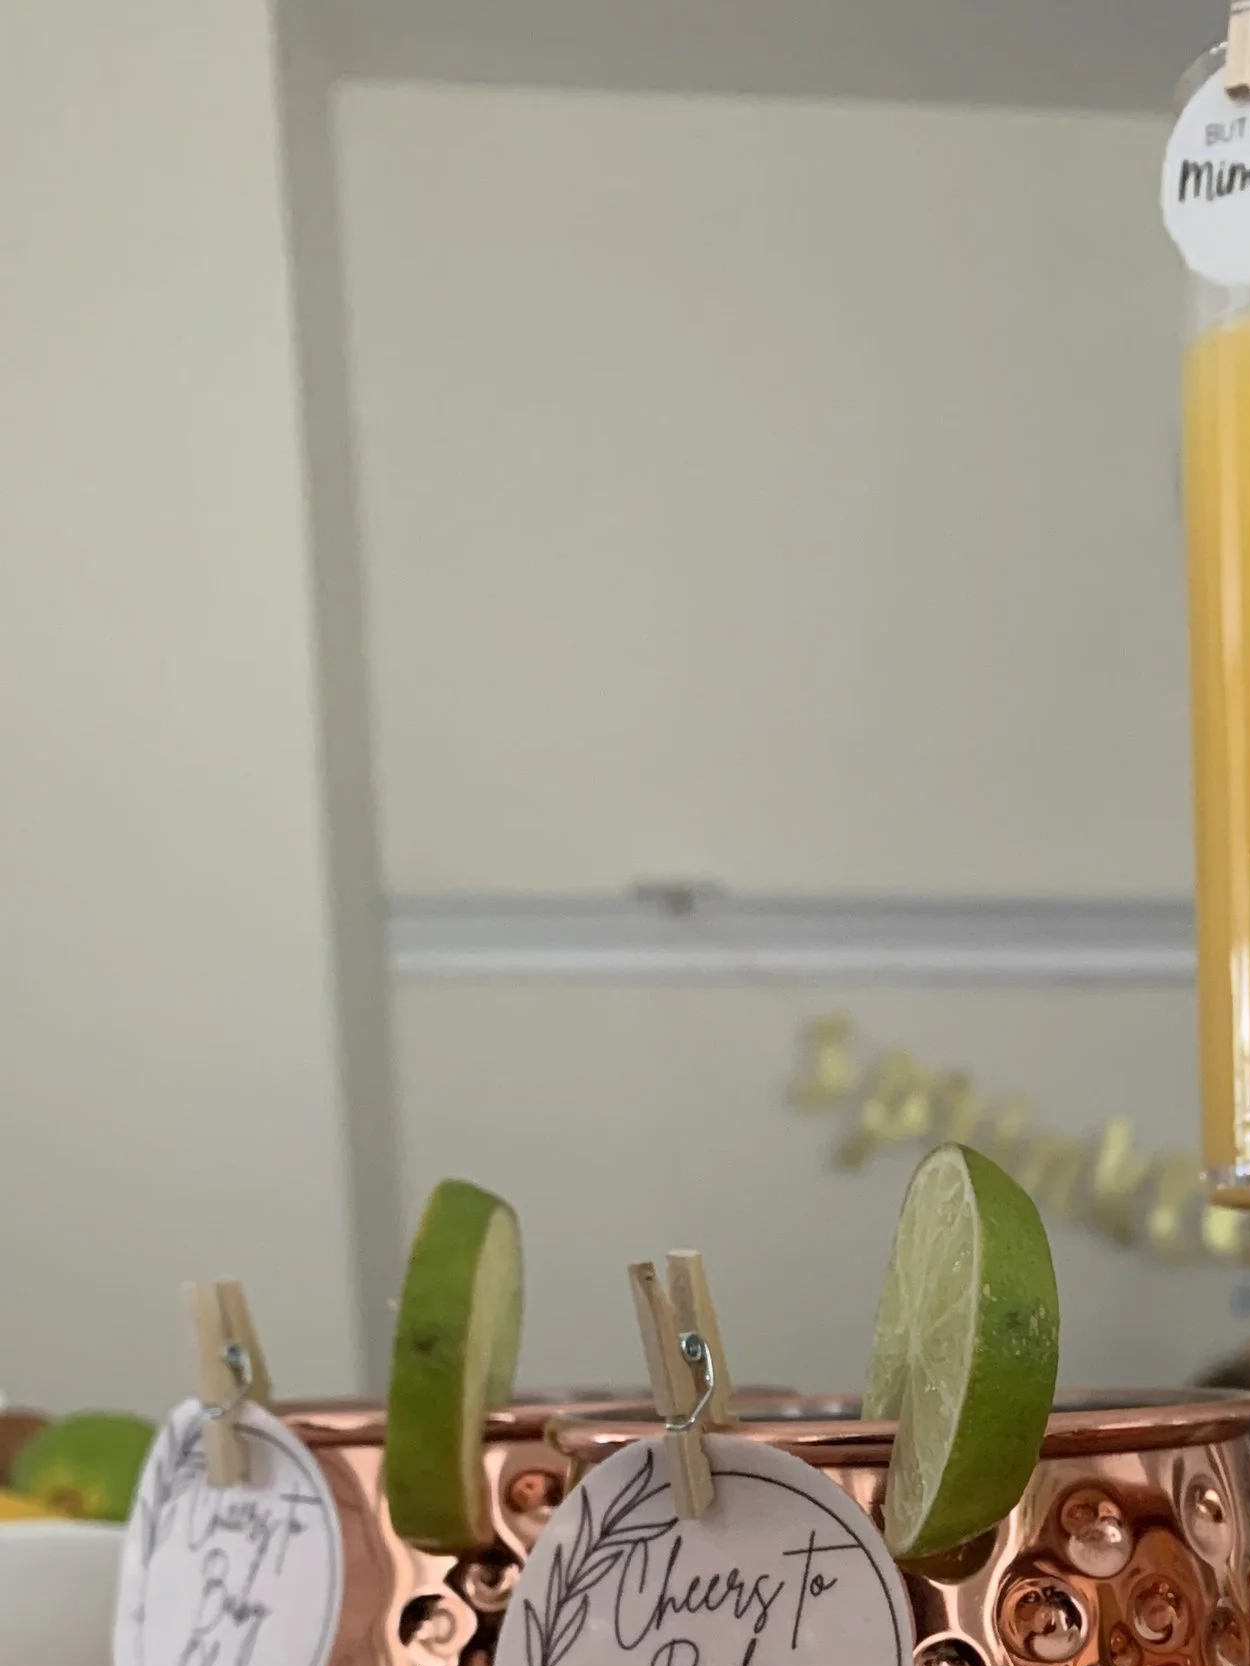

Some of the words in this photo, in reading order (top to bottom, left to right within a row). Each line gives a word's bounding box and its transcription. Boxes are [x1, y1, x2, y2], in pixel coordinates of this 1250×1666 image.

[1205, 117, 1247, 147] BUT
[614, 1535, 785, 1651] Cheers
[782, 1529, 862, 1650] to
